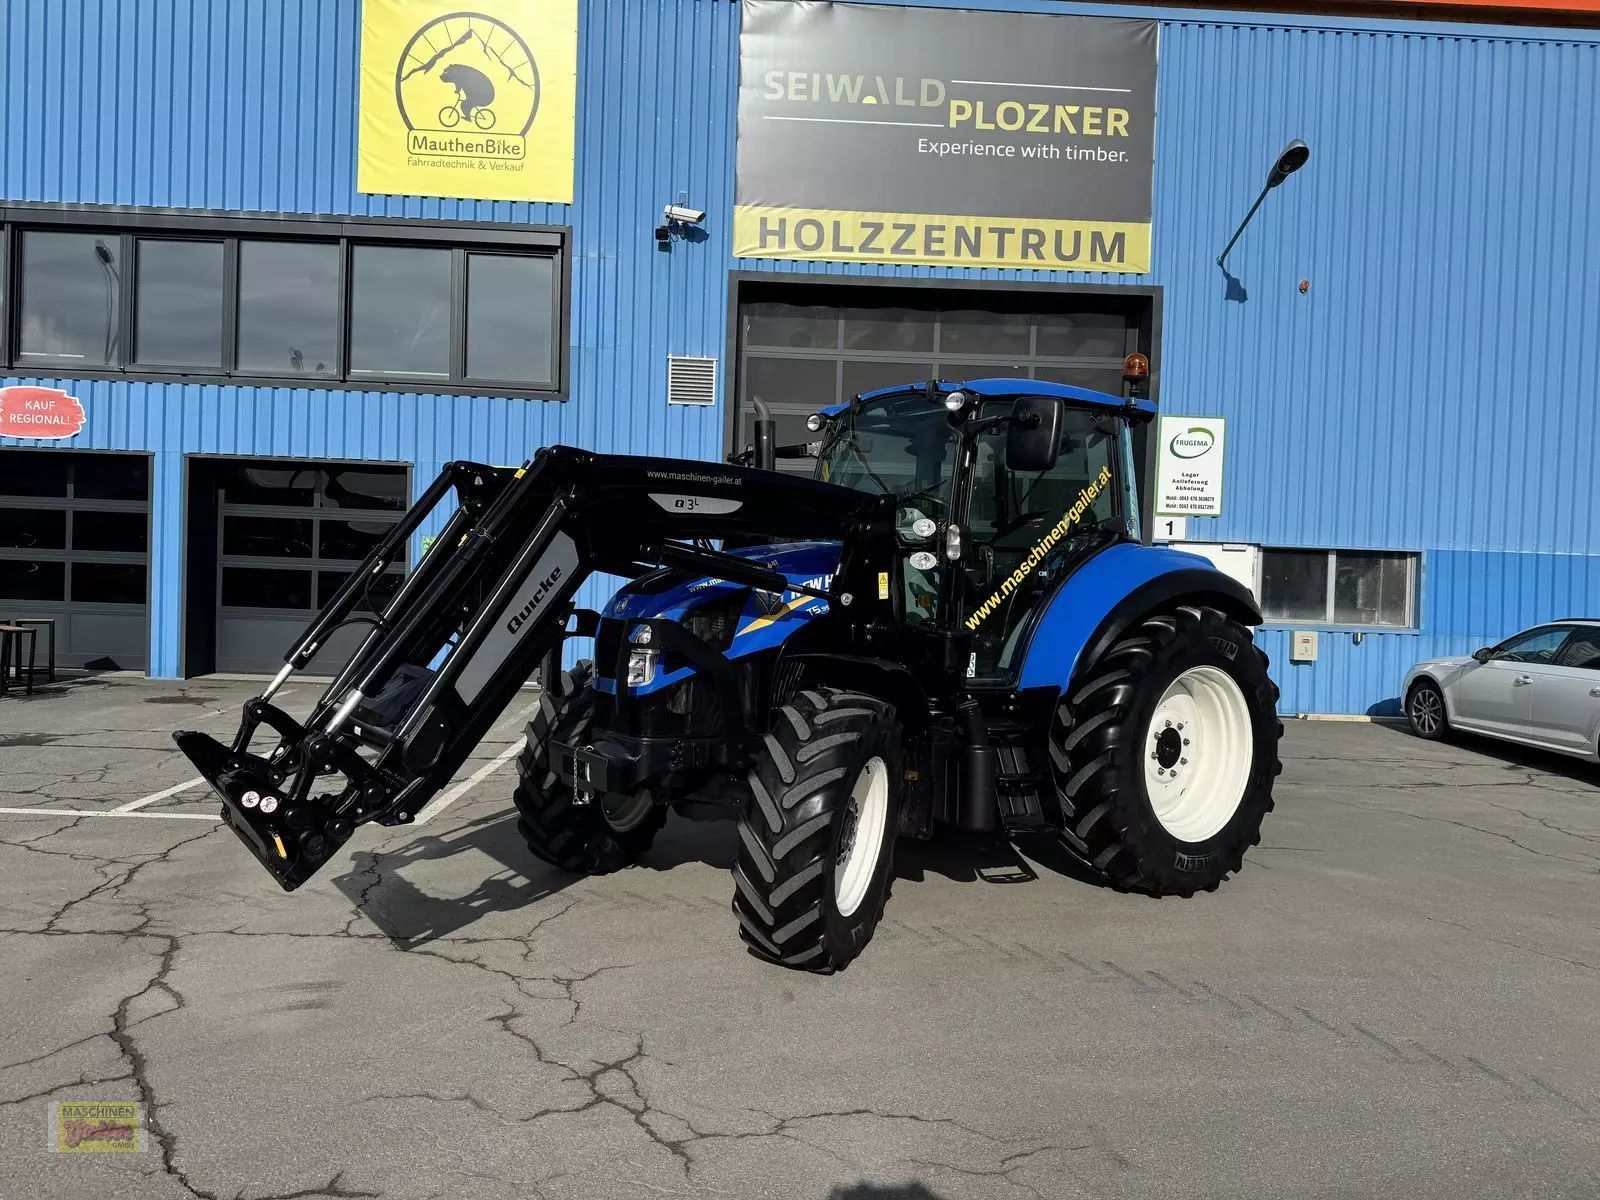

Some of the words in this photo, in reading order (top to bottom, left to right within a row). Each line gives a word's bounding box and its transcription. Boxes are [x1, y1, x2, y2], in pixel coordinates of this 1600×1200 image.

[763, 69, 946, 108] SEIWALD
[948, 99, 1131, 137] PLOZNER
[411, 135, 521, 156] MauthenBike
[917, 138, 1015, 158] Experience
[1020, 142, 1060, 160] with
[1065, 144, 1130, 163] timber.
[407, 157, 475, 170] Fahrradtechnik
[477, 161, 487, 170] &
[489, 161, 525, 172] Verkauf
[757, 215, 1127, 264] HOLZZENTRUM
[25, 400, 56, 410] KAUF
[9, 413, 70, 425] REGIONAL!
[1175, 439, 1209, 447] FRUGEMA
[646, 470, 743, 486] www.maschinen-gailer.at
[1165, 520, 1174, 536] 1
[965, 465, 1112, 631] www.maschinen-gailer.at
[506, 566, 562, 635] Quicke
